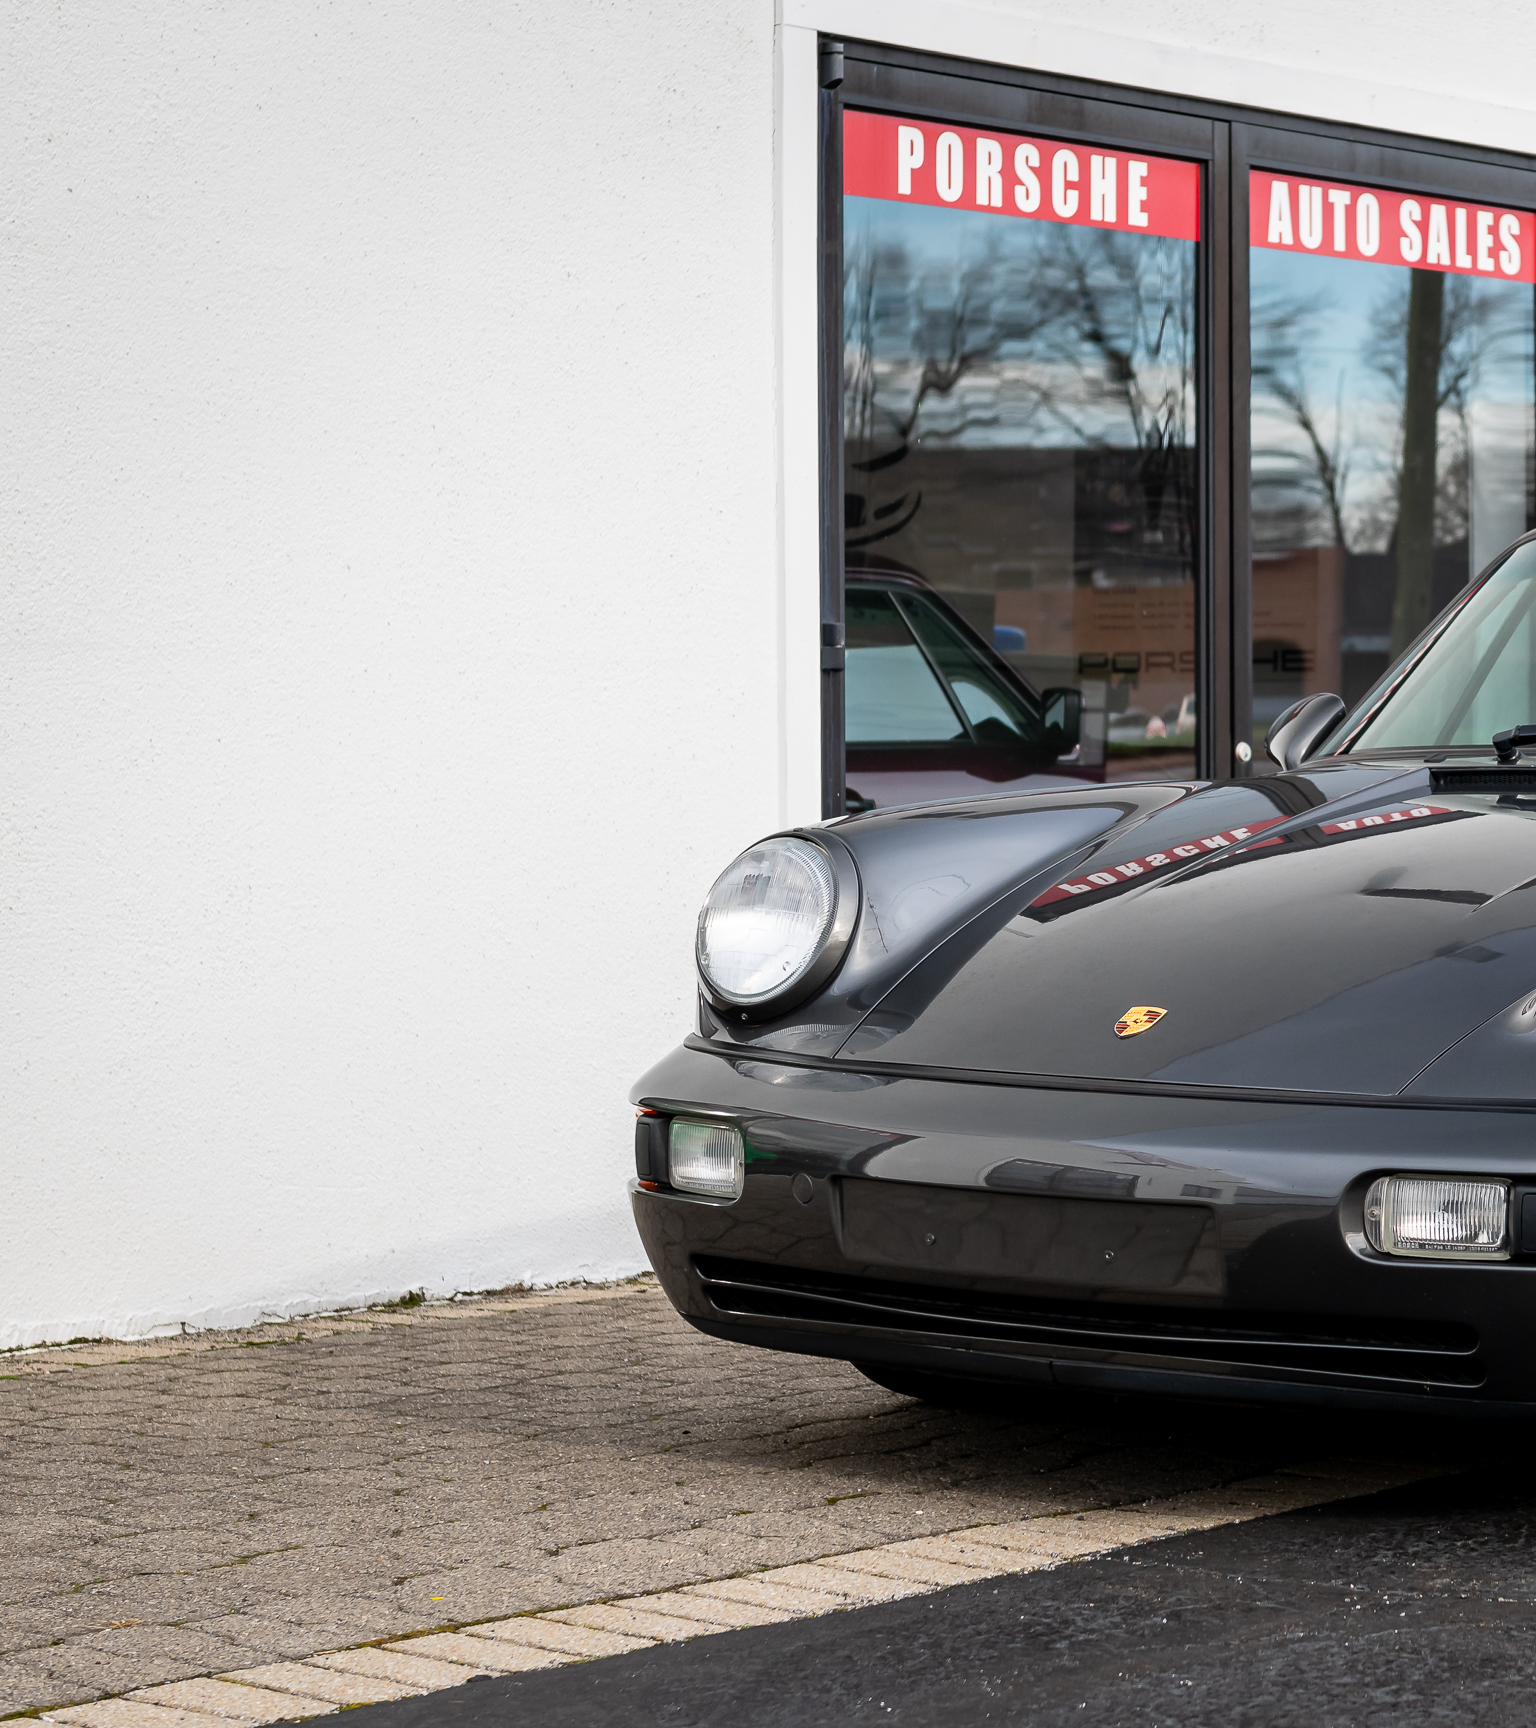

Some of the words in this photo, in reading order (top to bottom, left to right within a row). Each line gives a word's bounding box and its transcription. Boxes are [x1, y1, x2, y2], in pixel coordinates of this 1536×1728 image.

[897, 125, 1149, 228] PORSCHE
[1267, 180, 1381, 258] AUTO
[1400, 198, 1522, 276] SALES
[1078, 649, 1315, 674] PORSHE
